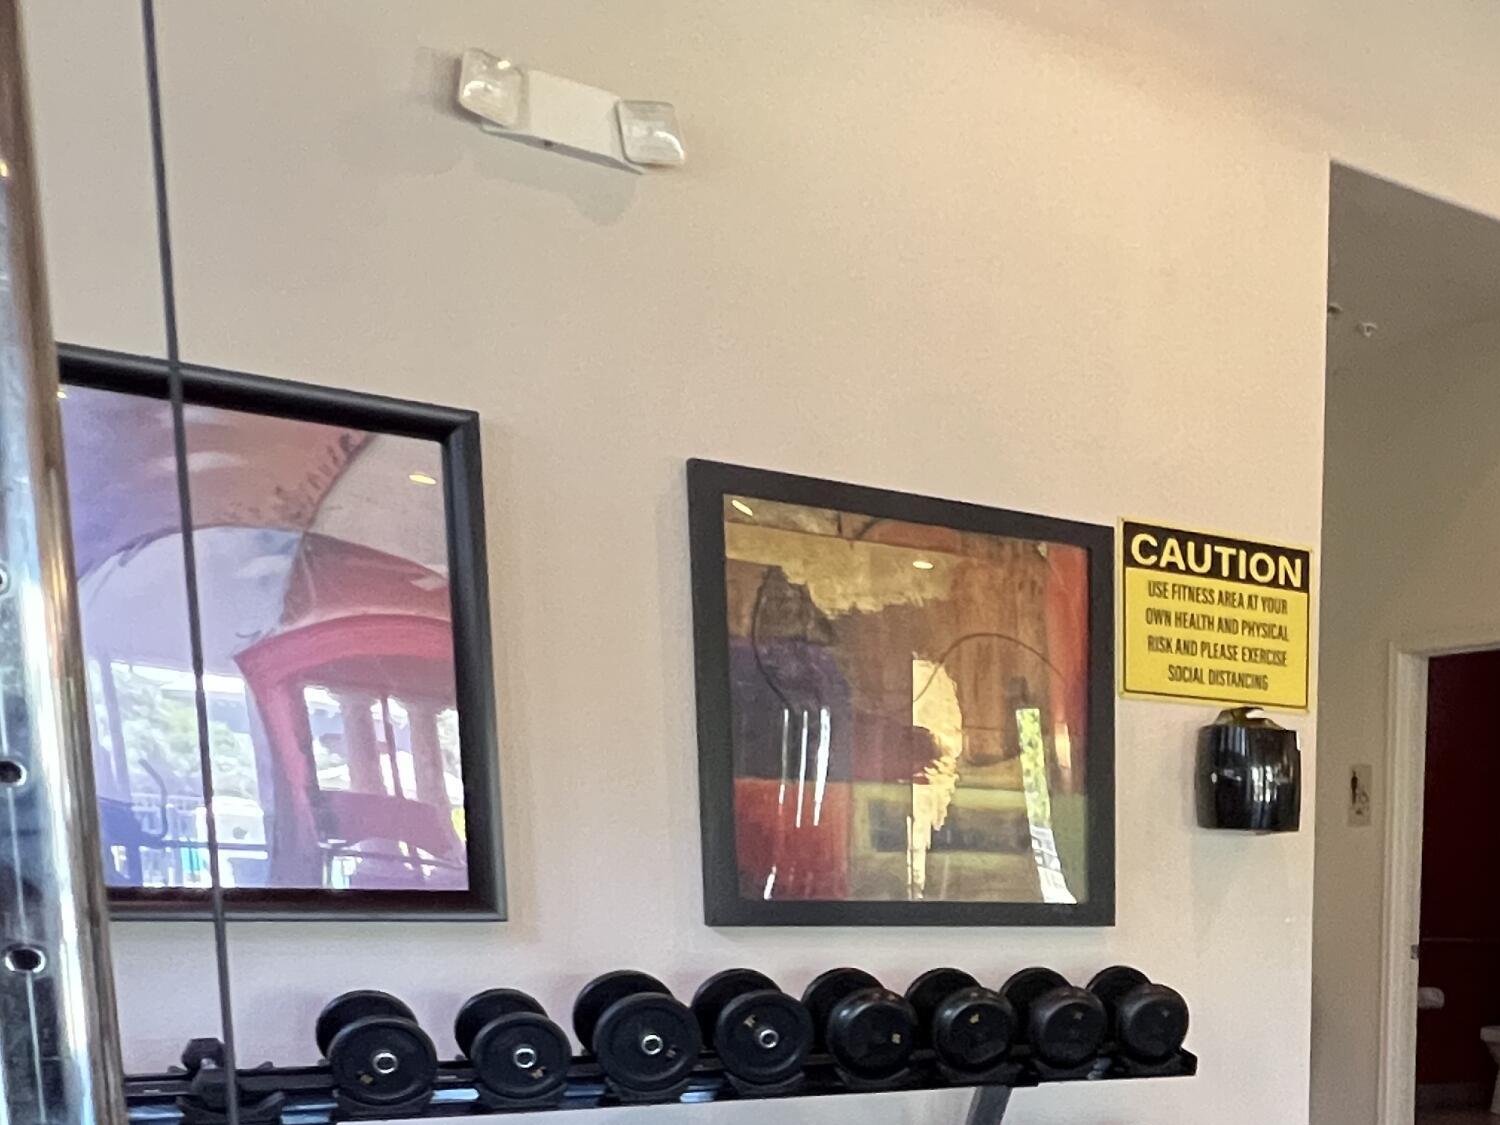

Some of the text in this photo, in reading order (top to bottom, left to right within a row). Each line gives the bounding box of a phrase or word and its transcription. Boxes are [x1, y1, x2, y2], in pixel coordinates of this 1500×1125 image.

[1131, 533, 1302, 587] CAUTION
[1148, 580, 1288, 615] USE FITNESS AREA AT YOUR
[1145, 607, 1289, 641] OWN HEALTH AND PHYSICAL
[1147, 635, 1288, 667] RISK AND PLEASE EXERCISE
[1168, 664, 1269, 690] SOCIAL DISTANCING
